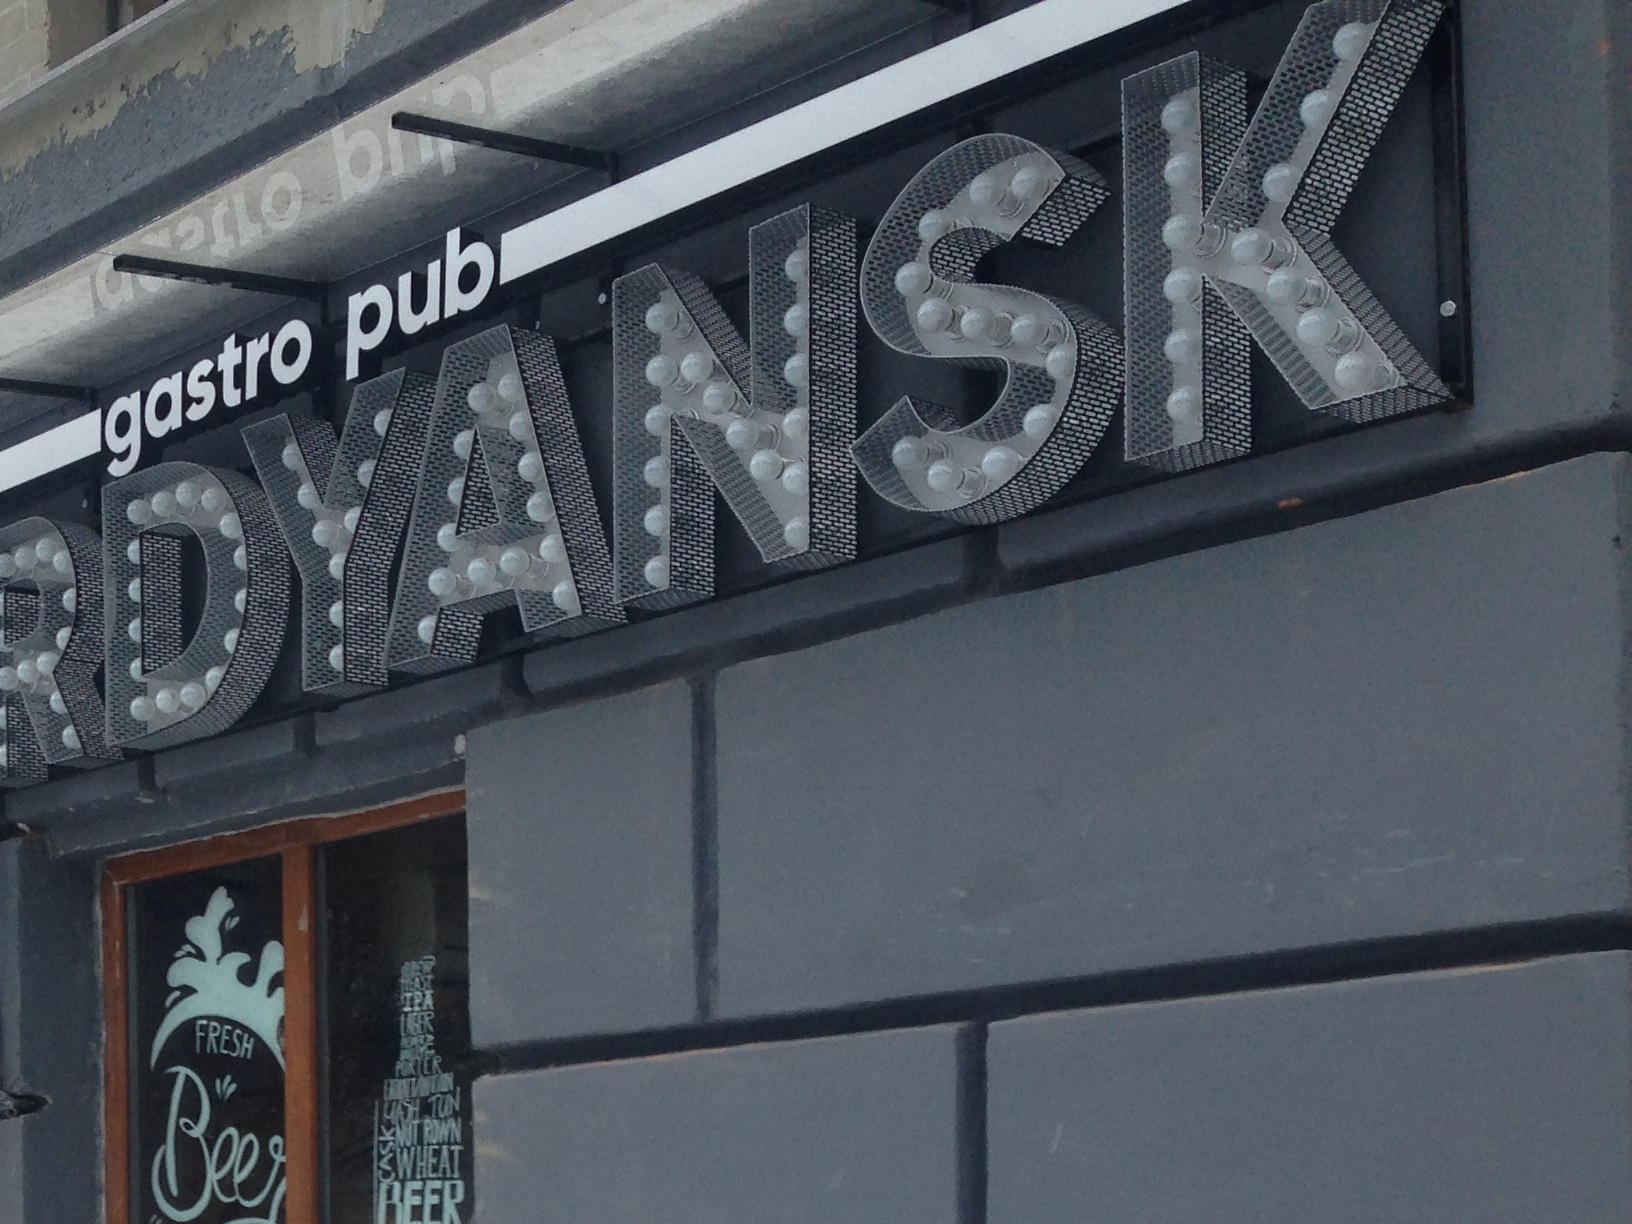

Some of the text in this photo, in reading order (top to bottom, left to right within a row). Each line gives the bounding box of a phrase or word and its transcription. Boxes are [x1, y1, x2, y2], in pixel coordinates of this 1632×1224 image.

[105, 227, 496, 478] gastro pub
[195, 1019, 256, 1059] FRESH
[151, 1065, 287, 1222] Beer
[396, 1145, 464, 1180] WHEAT
